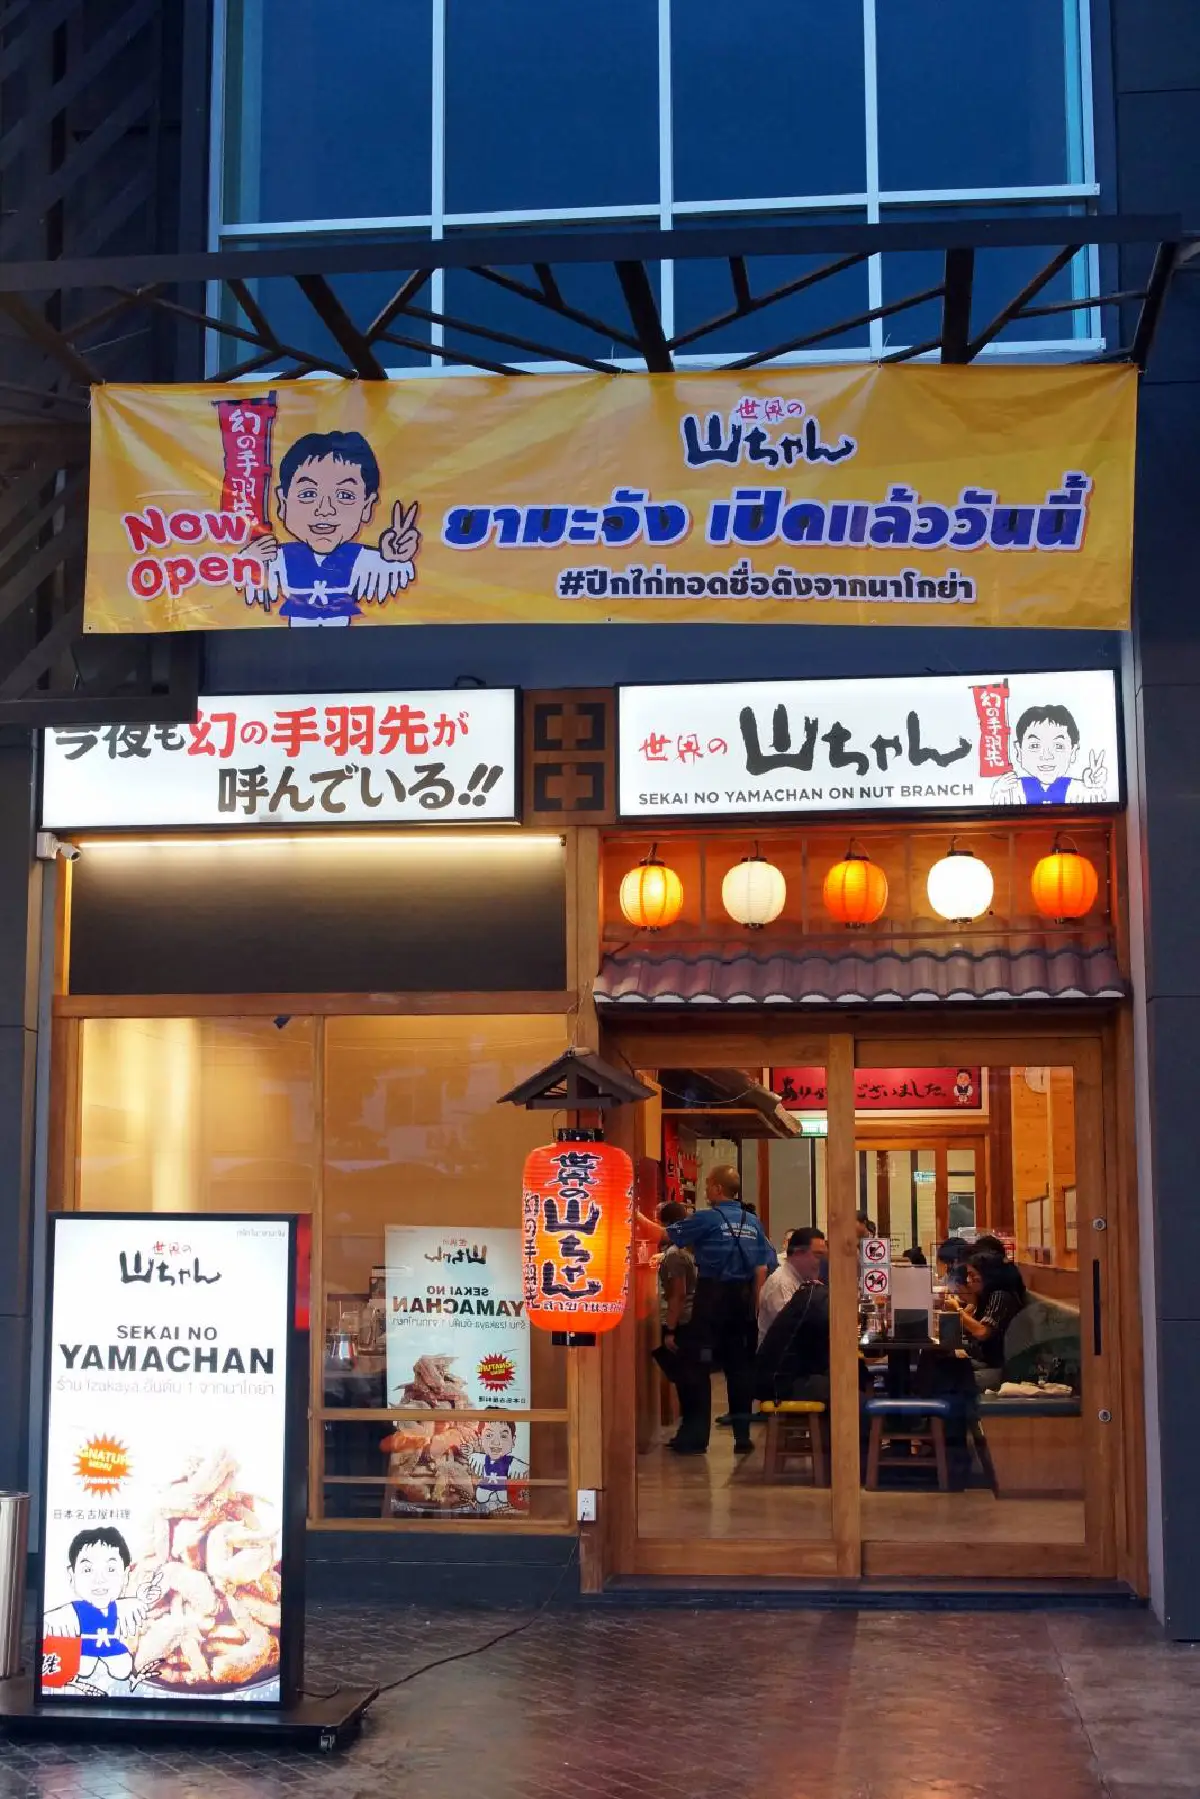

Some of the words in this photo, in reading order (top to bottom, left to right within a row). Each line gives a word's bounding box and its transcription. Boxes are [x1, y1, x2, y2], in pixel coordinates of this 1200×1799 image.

[736, 398, 802, 421] 世界の
[684, 415, 855, 466] 山ちゃん
[125, 508, 247, 551] Now
[444, 489, 688, 545] ยามะจัง
[709, 475, 1087, 546] เปิดแล้ววันนี้
[132, 556, 262, 597] Open
[638, 732, 728, 765] 世界の
[739, 704, 973, 776] 山ちゃん
[980, 690, 1004, 767] 幻の手羽先
[639, 793, 688, 805] SEKAI
[694, 791, 720, 804] NO
[725, 787, 823, 803] YAMACHAN
[828, 787, 855, 800] ON
[859, 785, 895, 799] NUT
[900, 783, 974, 798] BRANCH
[119, 1250, 223, 1287] 山ちゃん
[117, 1325, 180, 1340] SEKAI
[188, 1326, 218, 1341] NO
[60, 1345, 274, 1374] YAMACHAN
